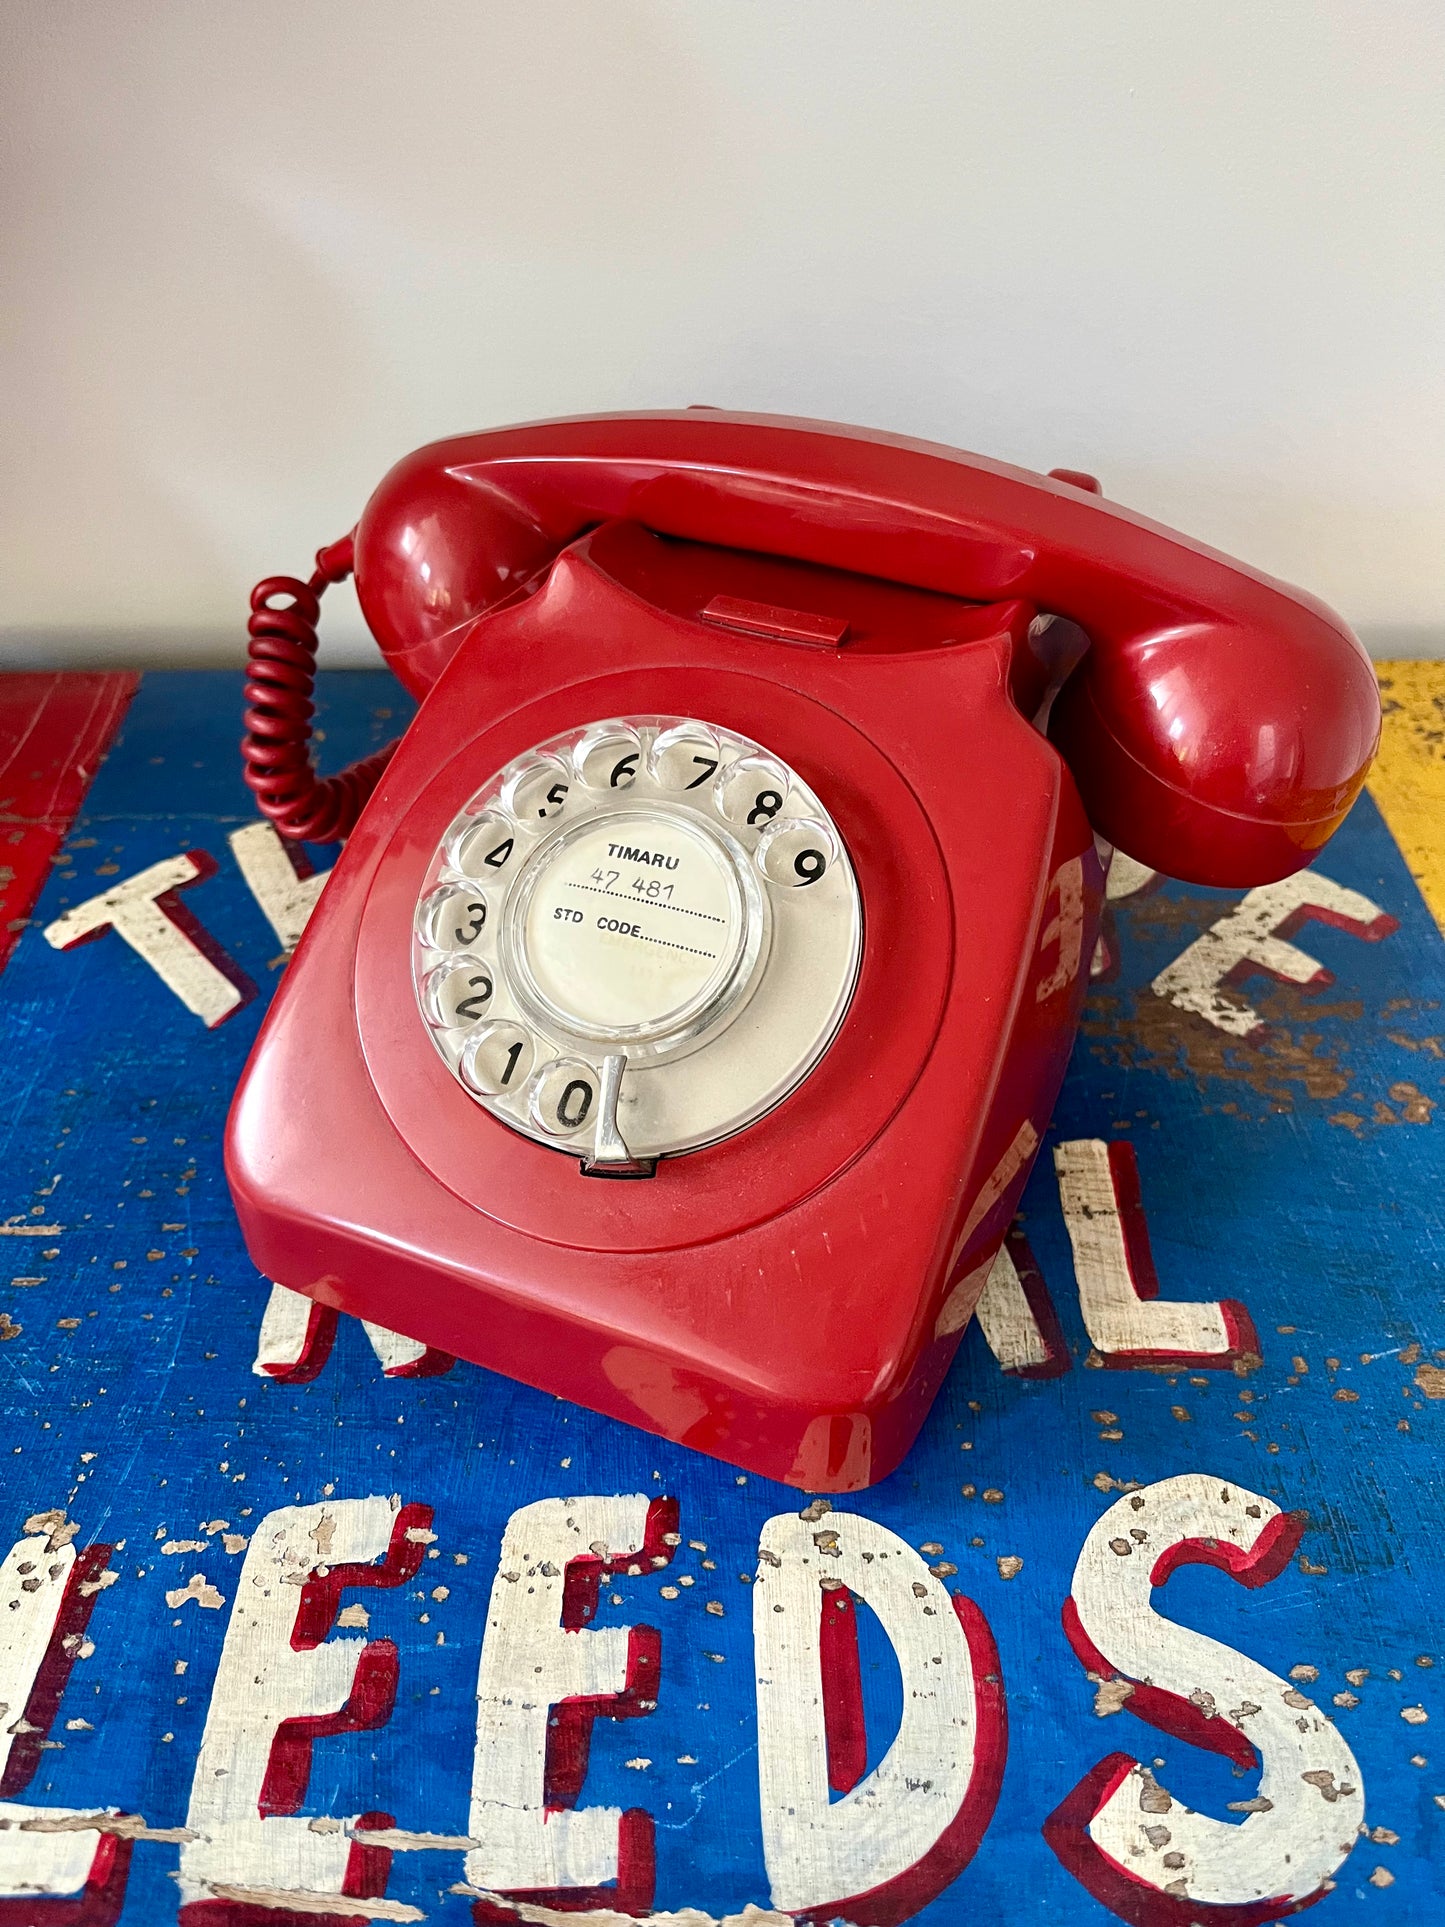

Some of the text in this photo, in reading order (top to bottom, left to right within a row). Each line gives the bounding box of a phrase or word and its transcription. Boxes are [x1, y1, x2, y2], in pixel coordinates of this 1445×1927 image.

[610, 753, 640, 788] 6
[683, 756, 718, 790] 7
[538, 783, 569, 818] 5
[746, 790, 783, 825] 8
[484, 838, 514, 868] 4
[608, 843, 680, 870] TIMARU
[792, 848, 826, 888] 9
[591, 867, 675, 901] 47 481
[455, 902, 487, 945] 3
[553, 907, 584, 923] STD
[455, 975, 493, 1020] 2
[500, 1041, 523, 1085] 1
[556, 1079, 593, 1128] 0
